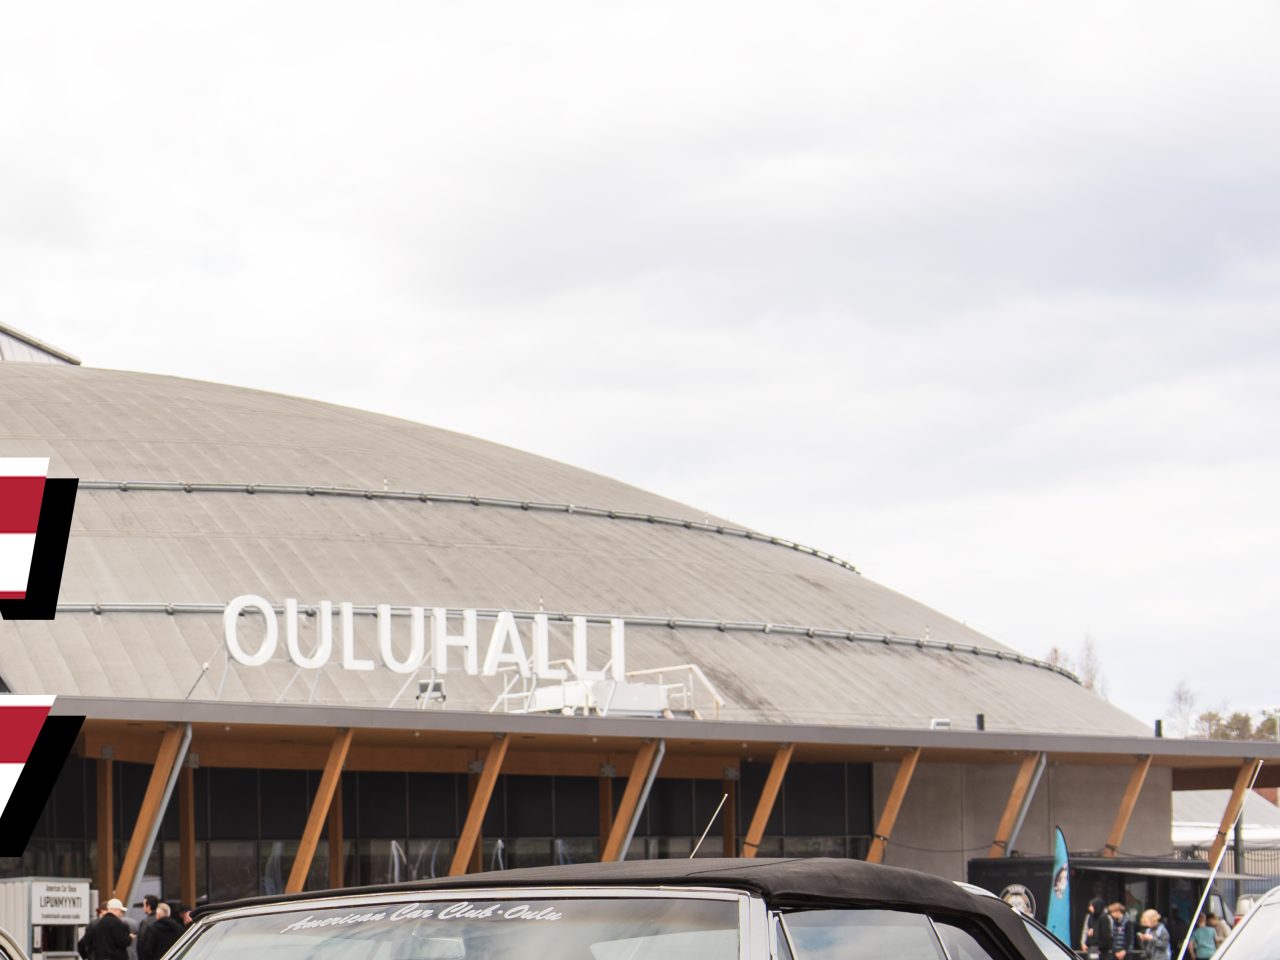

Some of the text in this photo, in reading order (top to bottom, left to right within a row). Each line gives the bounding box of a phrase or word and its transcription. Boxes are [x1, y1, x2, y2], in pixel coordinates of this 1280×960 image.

[223, 594, 625, 681] OULUHALLI
[280, 902, 563, 934] American Car Club Oulu
